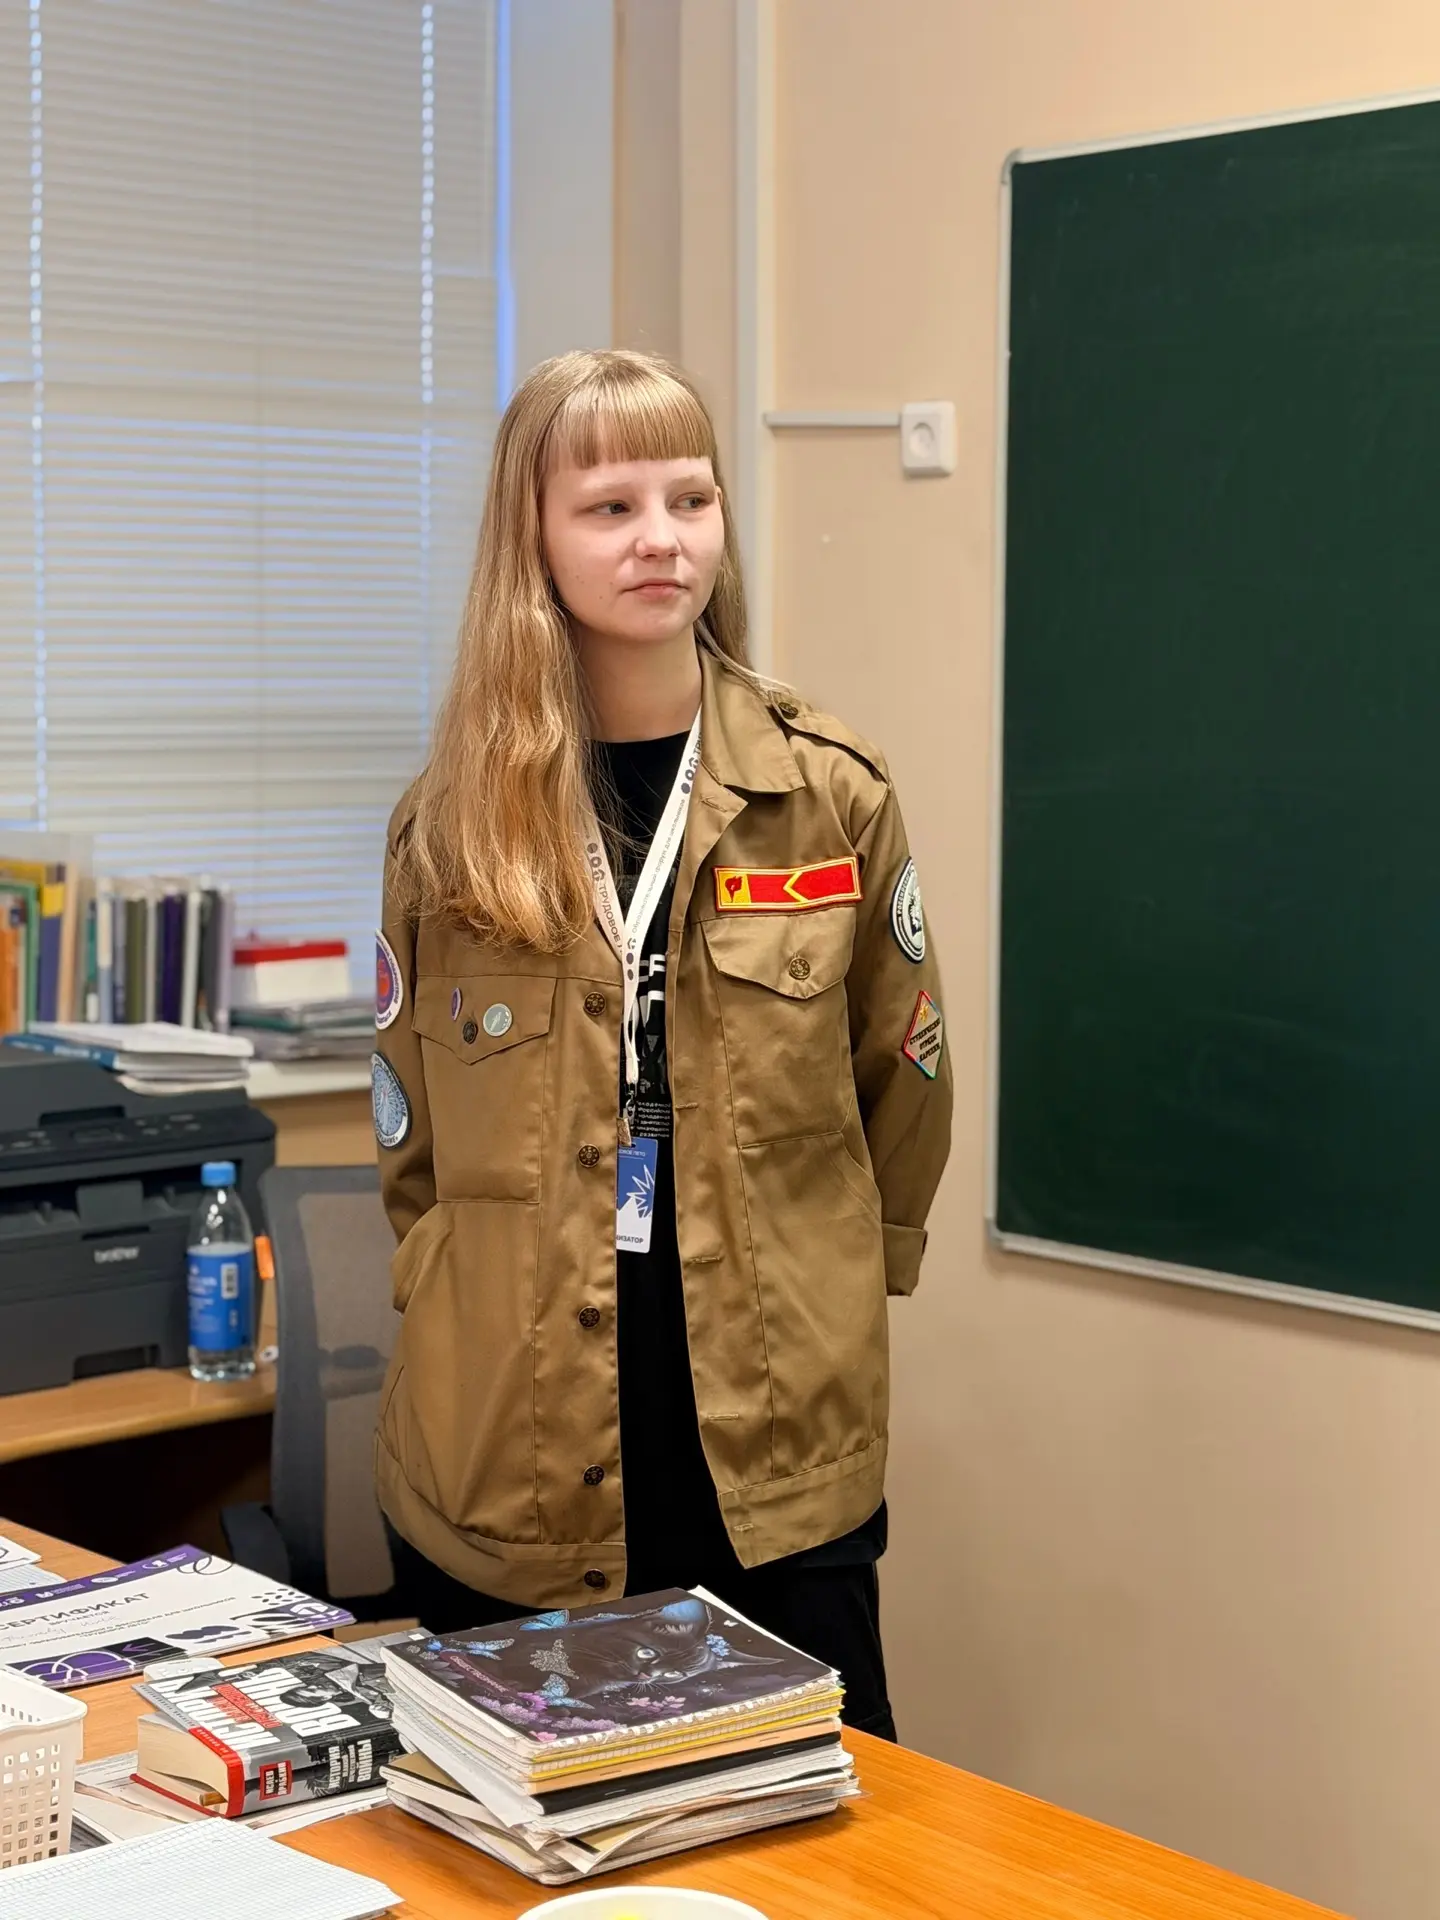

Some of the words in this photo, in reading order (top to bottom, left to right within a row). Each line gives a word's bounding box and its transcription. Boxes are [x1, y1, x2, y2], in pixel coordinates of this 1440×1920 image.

[599, 883, 621, 944] ТРУДОВОЕ
[0, 1592, 150, 1631] СЕРТИФИКАТ
[148, 1676, 282, 1751] ИСТОРИЯ
[265, 1769, 276, 1795] ИСАЕВ
[328, 1745, 341, 1789] ИСТОРИЯ
[356, 1738, 373, 1783] ВОЙНЫ
